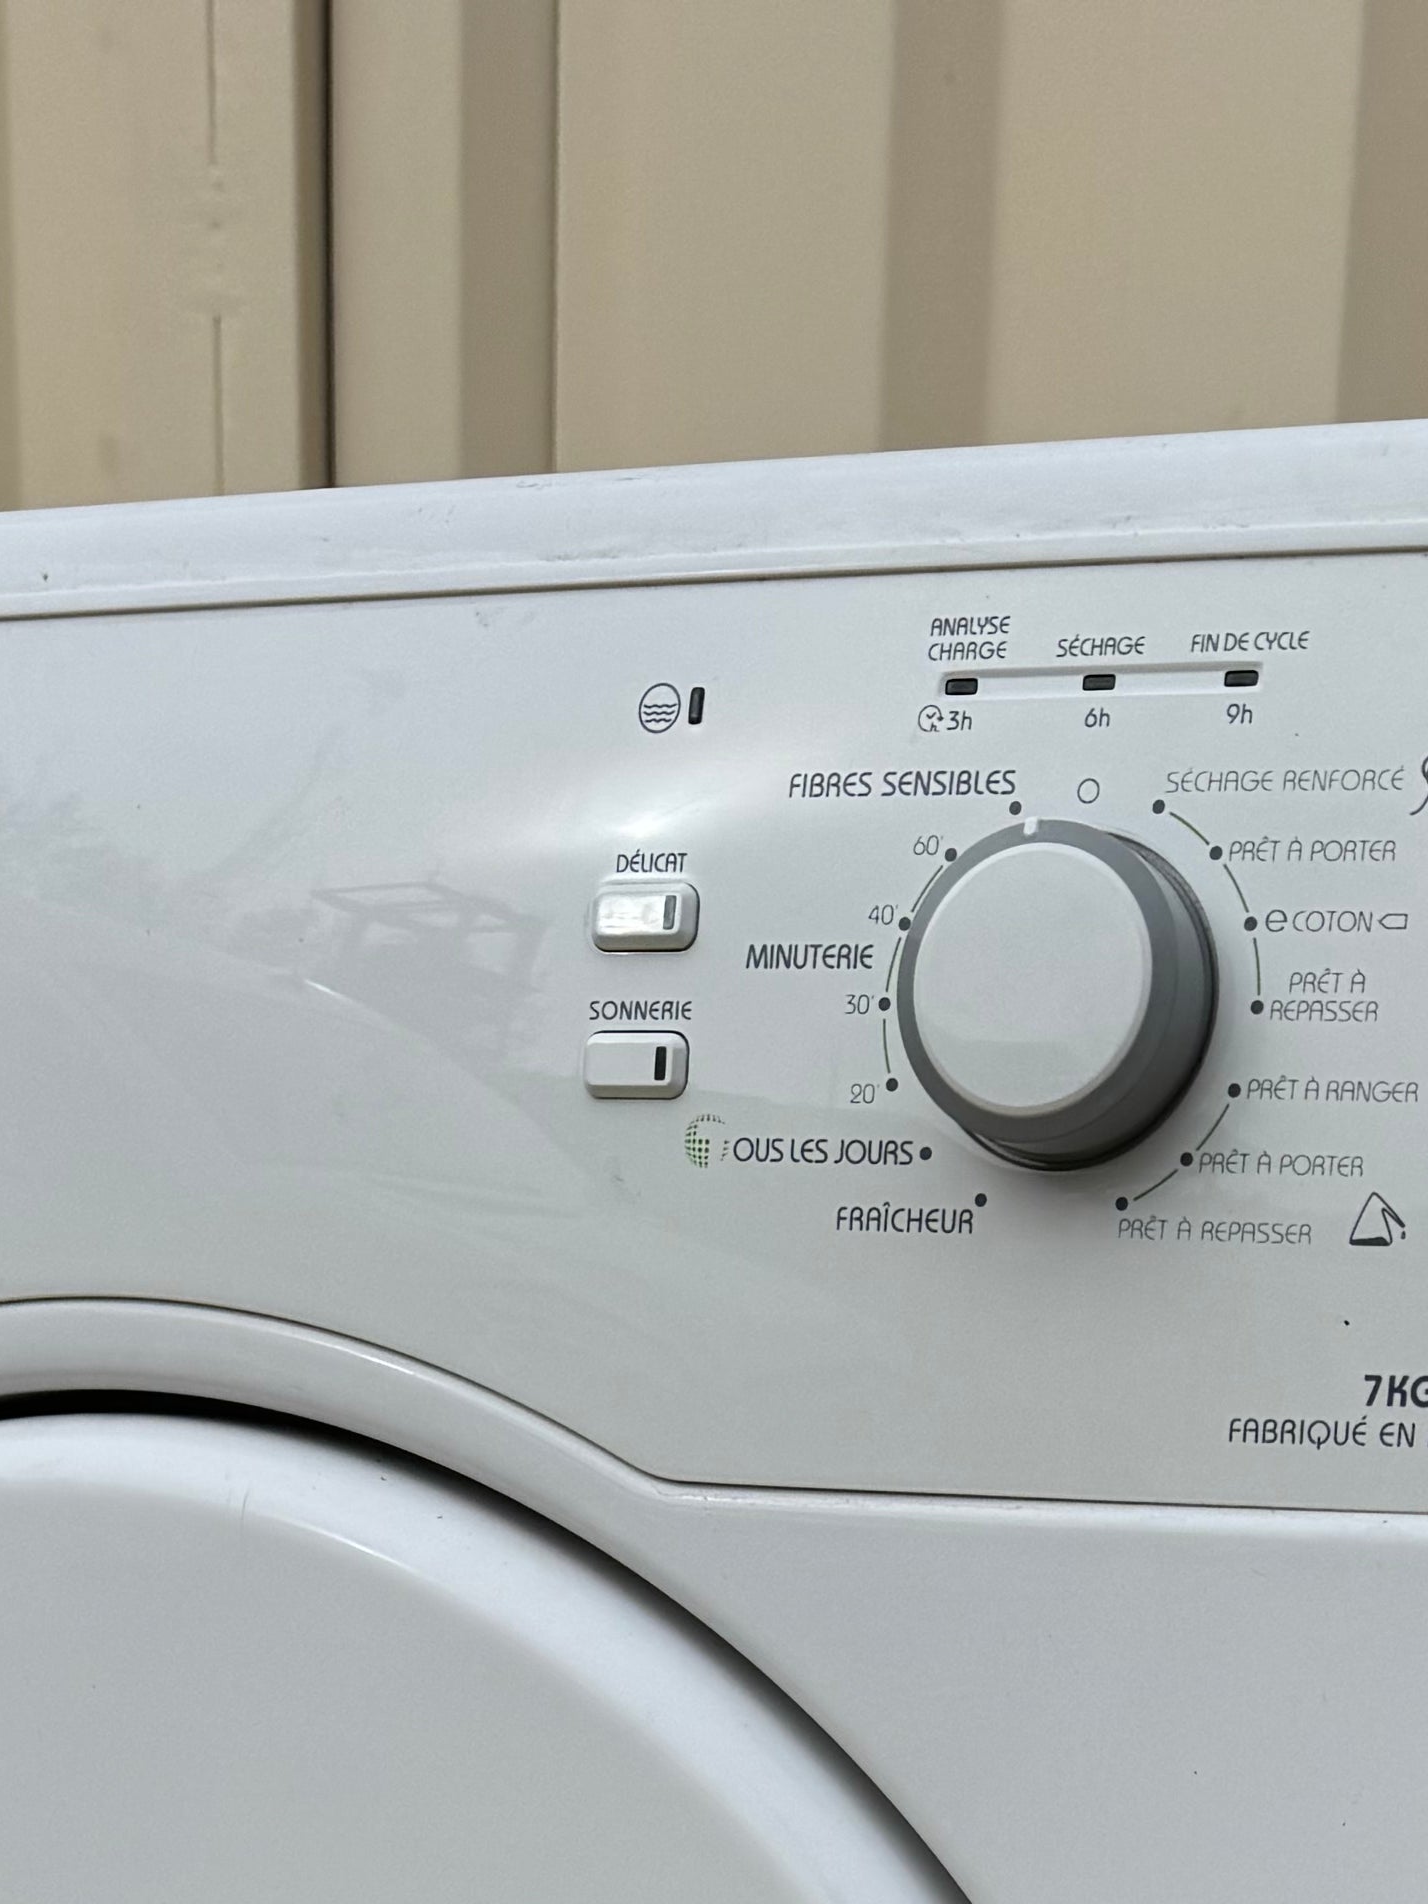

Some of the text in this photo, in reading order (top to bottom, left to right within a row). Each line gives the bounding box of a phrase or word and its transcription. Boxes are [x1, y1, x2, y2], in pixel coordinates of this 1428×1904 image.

[930, 615, 1011, 637] ANALYSE
[927, 640, 1008, 662] CHARGE
[1055, 633, 1146, 658] SÉCHAGE
[1190, 630, 1311, 654] FIN DE CYCLE
[946, 709, 973, 731] 3h
[1084, 706, 1111, 729] 6h
[1226, 703, 1253, 725] 9h
[788, 769, 1017, 799] FIBRES SENSIBLES
[1164, 764, 1405, 794] SÉCHAGE RENFORCÉ
[615, 848, 688, 874] DÉLICAT
[1228, 835, 1397, 863] PRÊT À PORTER
[1291, 910, 1374, 933] COTON
[745, 943, 875, 970] MINUTERIE
[1288, 967, 1366, 995] PRÊT À
[588, 1000, 693, 1021] SONNERIE
[1269, 999, 1379, 1023] REPASSER
[1246, 1074, 1419, 1103] PRÊT À RANGER
[790, 1138, 829, 1164] LES
[833, 1138, 914, 1166] JOURS
[1198, 1148, 1364, 1178] PRÊT À PORTER
[836, 1202, 974, 1235] FRAÎCHEUR
[1117, 1214, 1312, 1245] PRÊT À REPASSER
[1228, 1414, 1368, 1451] FABRIQUÉ
[1378, 1421, 1416, 1448] EN
